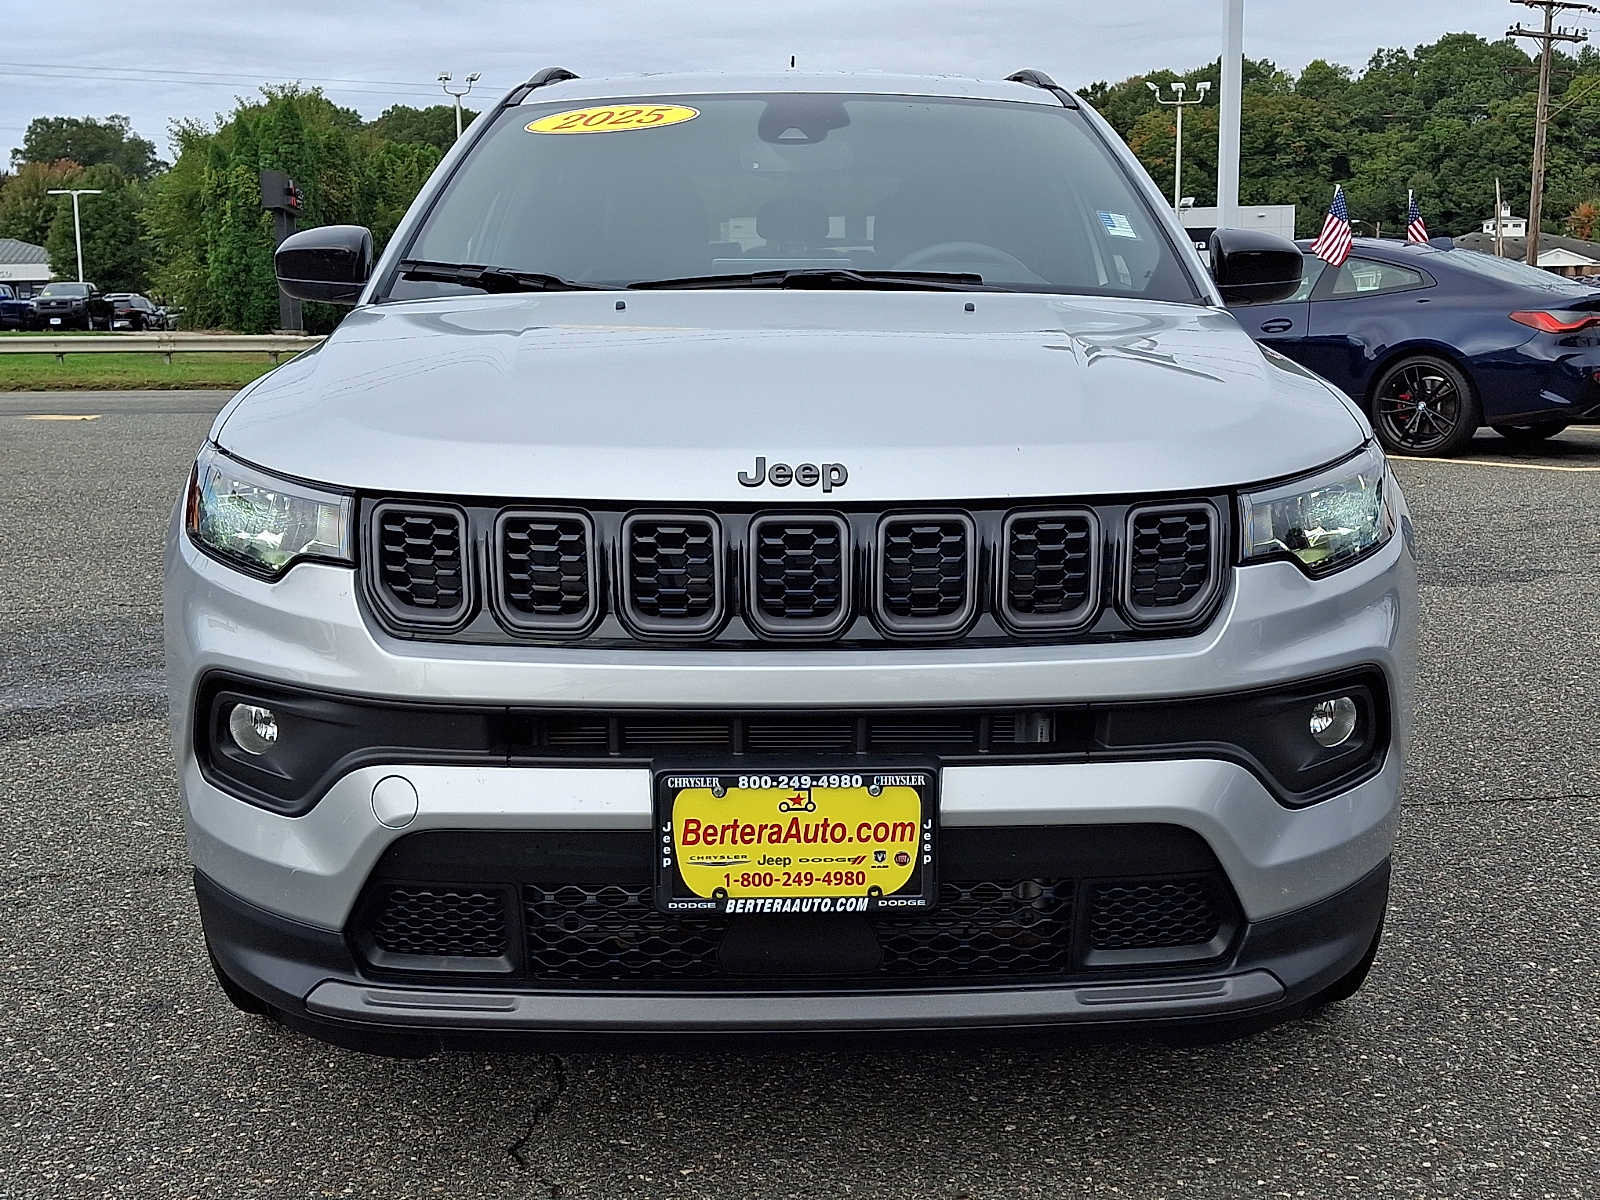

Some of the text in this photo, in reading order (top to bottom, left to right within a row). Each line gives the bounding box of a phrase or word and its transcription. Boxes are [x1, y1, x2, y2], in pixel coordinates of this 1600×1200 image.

[552, 108, 672, 130] 2025
[738, 456, 848, 493] Jeep
[667, 777, 720, 788] CHRYSLER
[738, 775, 863, 789] 800-249-4980
[873, 775, 926, 786] CHRYSLER
[681, 817, 916, 846] BerteraAuto.com
[662, 822, 672, 868] Jeep
[923, 818, 933, 865] Jeep
[757, 854, 792, 867] Jeep
[723, 870, 866, 888] 1-800-249-4980
[725, 898, 869, 914] BERTERAAUTO.COM
